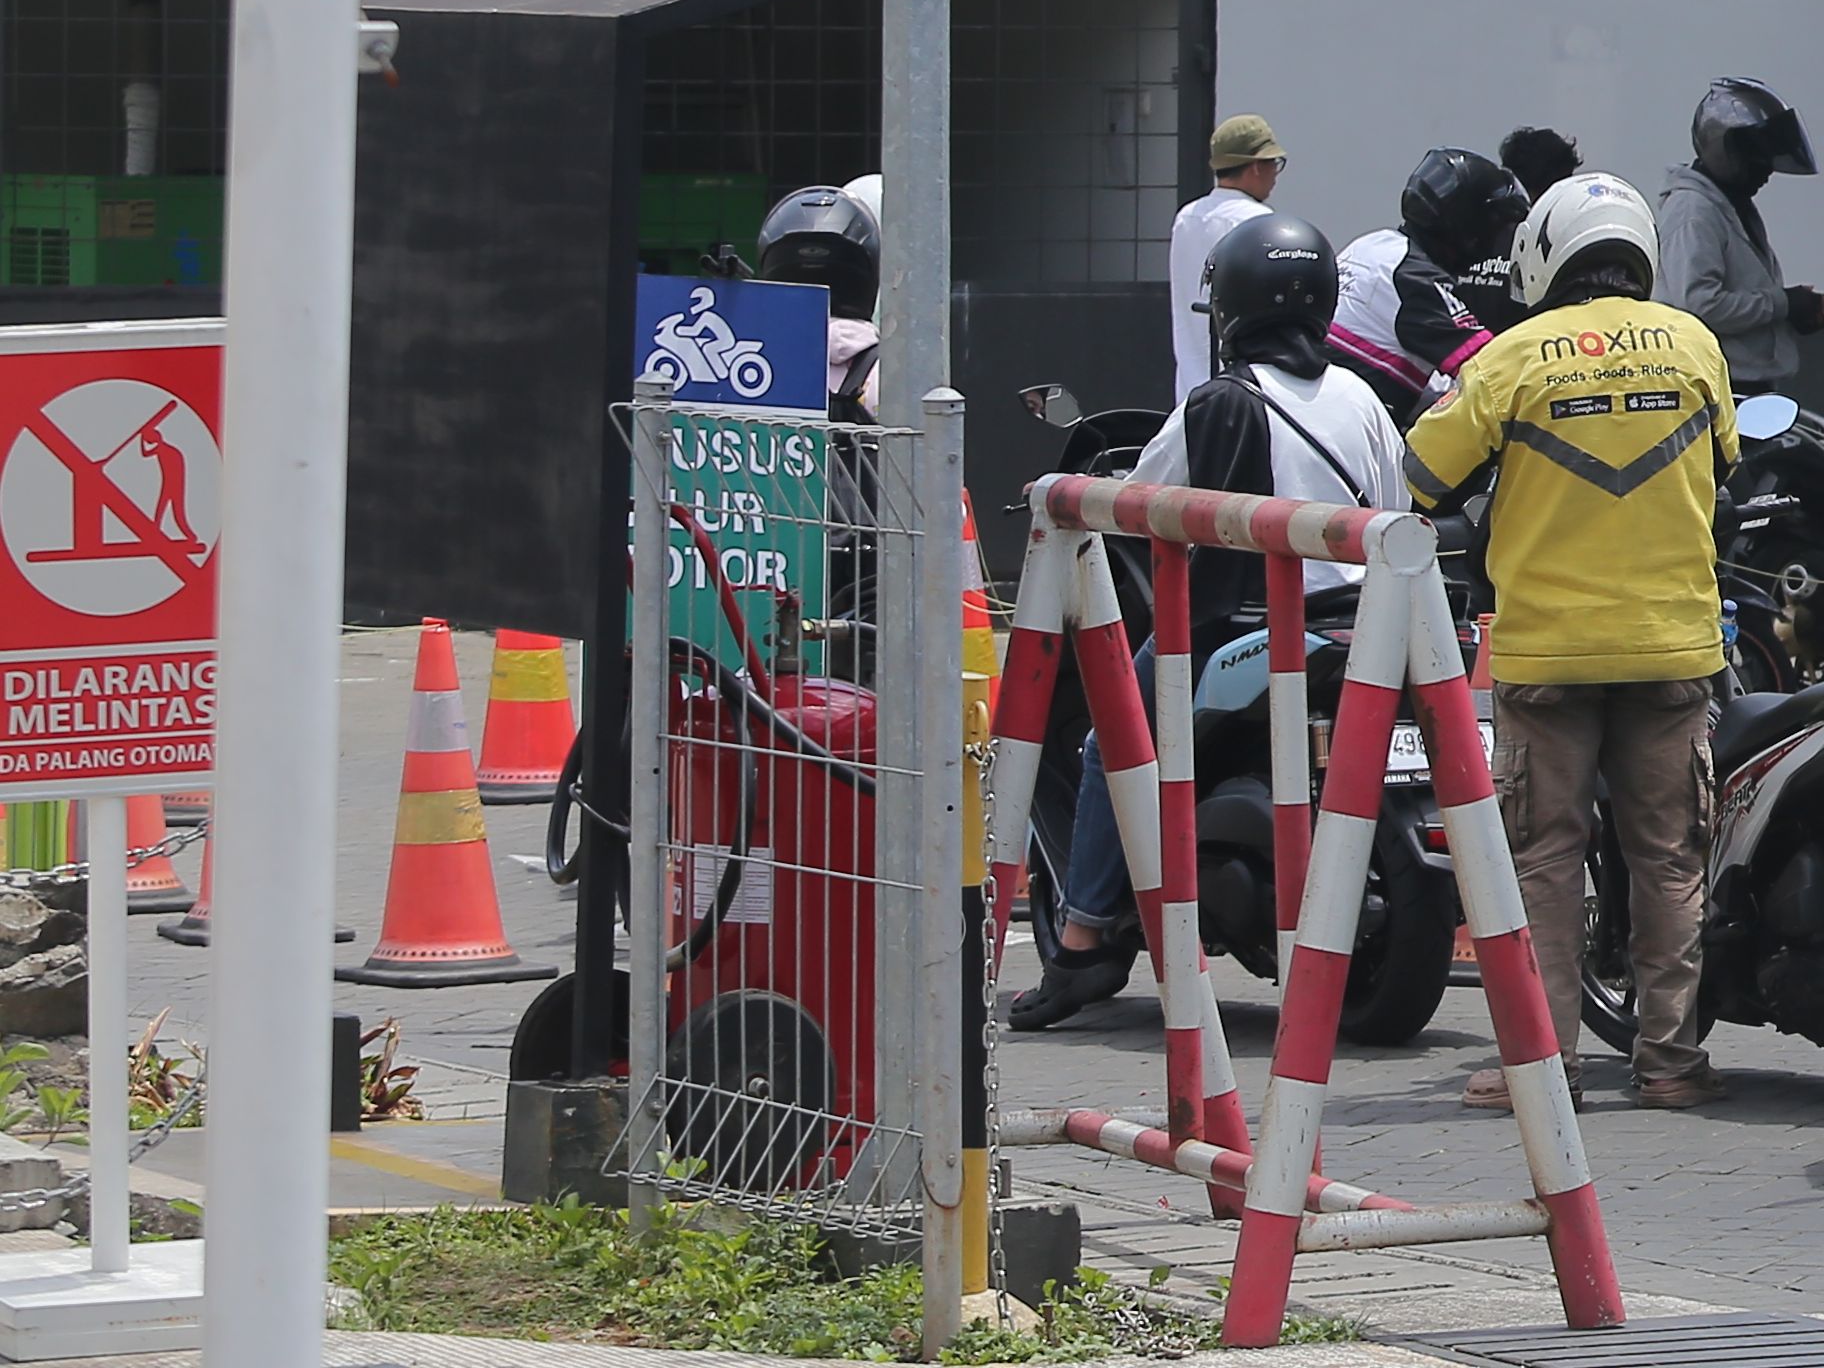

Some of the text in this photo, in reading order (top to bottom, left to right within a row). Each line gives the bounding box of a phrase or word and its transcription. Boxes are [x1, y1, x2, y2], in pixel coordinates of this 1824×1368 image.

[1541, 321, 1674, 362] maxim
[1546, 364, 1677, 386] Foods Goods Rides
[1570, 405, 1594, 413] Google
[1641, 399, 1676, 408] App Store
[672, 428, 816, 477] USUS
[628, 489, 766, 534] LUR
[627, 544, 790, 593] OTOR
[4, 660, 218, 701] DILARANG
[8, 695, 217, 735] MELINTAS
[35, 748, 125, 771] PALANG
[130, 743, 216, 765] OTOMA
